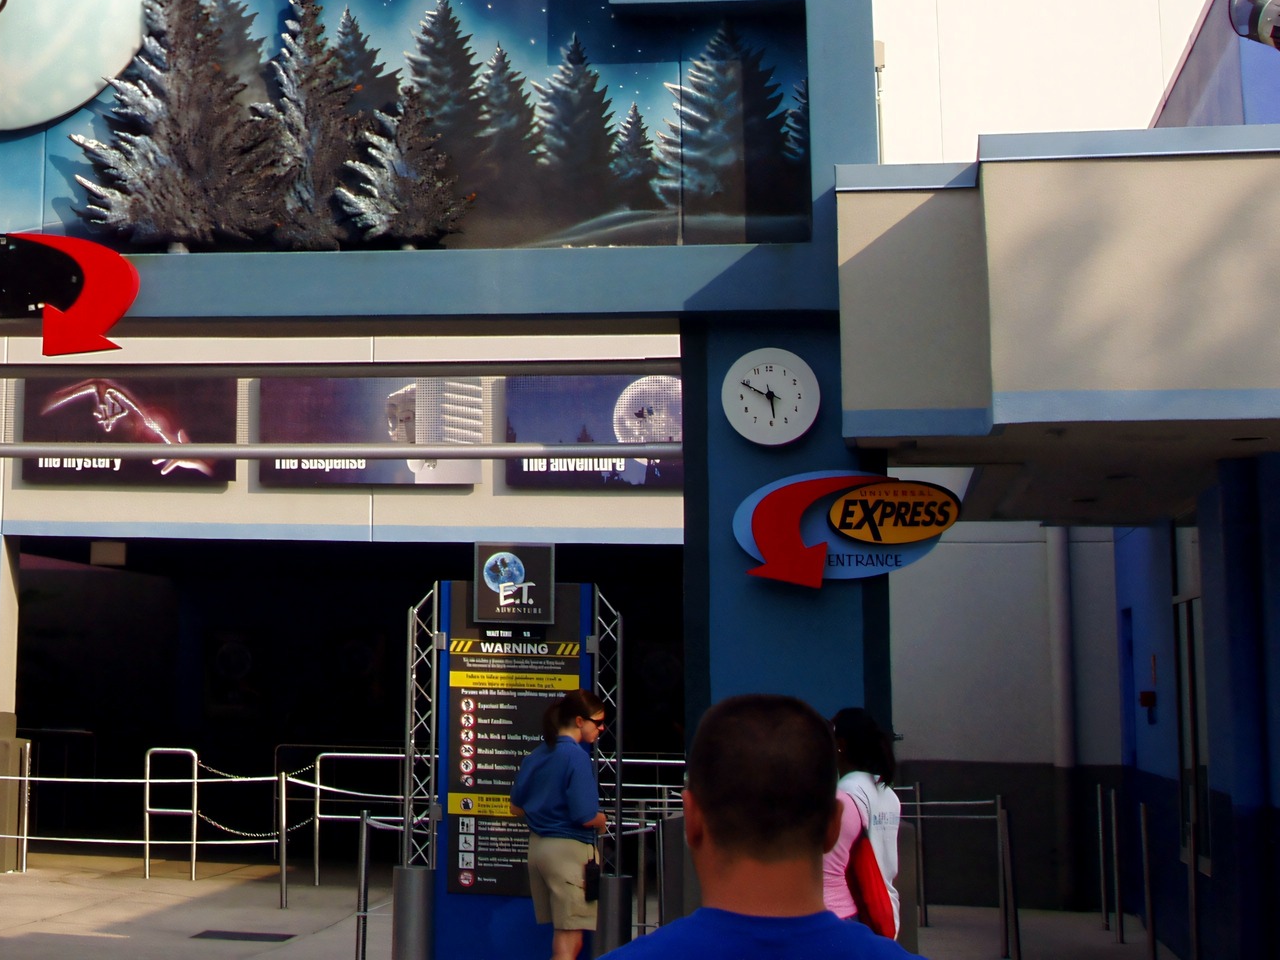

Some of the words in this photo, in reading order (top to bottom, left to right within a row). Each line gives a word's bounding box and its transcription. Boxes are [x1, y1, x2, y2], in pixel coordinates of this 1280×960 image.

[859, 489, 934, 497] UNIVERSAL
[838, 499, 951, 542] EXPRESS
[827, 553, 902, 567] ENTRANCE
[499, 581, 537, 606] E.T.
[480, 642, 549, 655] WARNING
